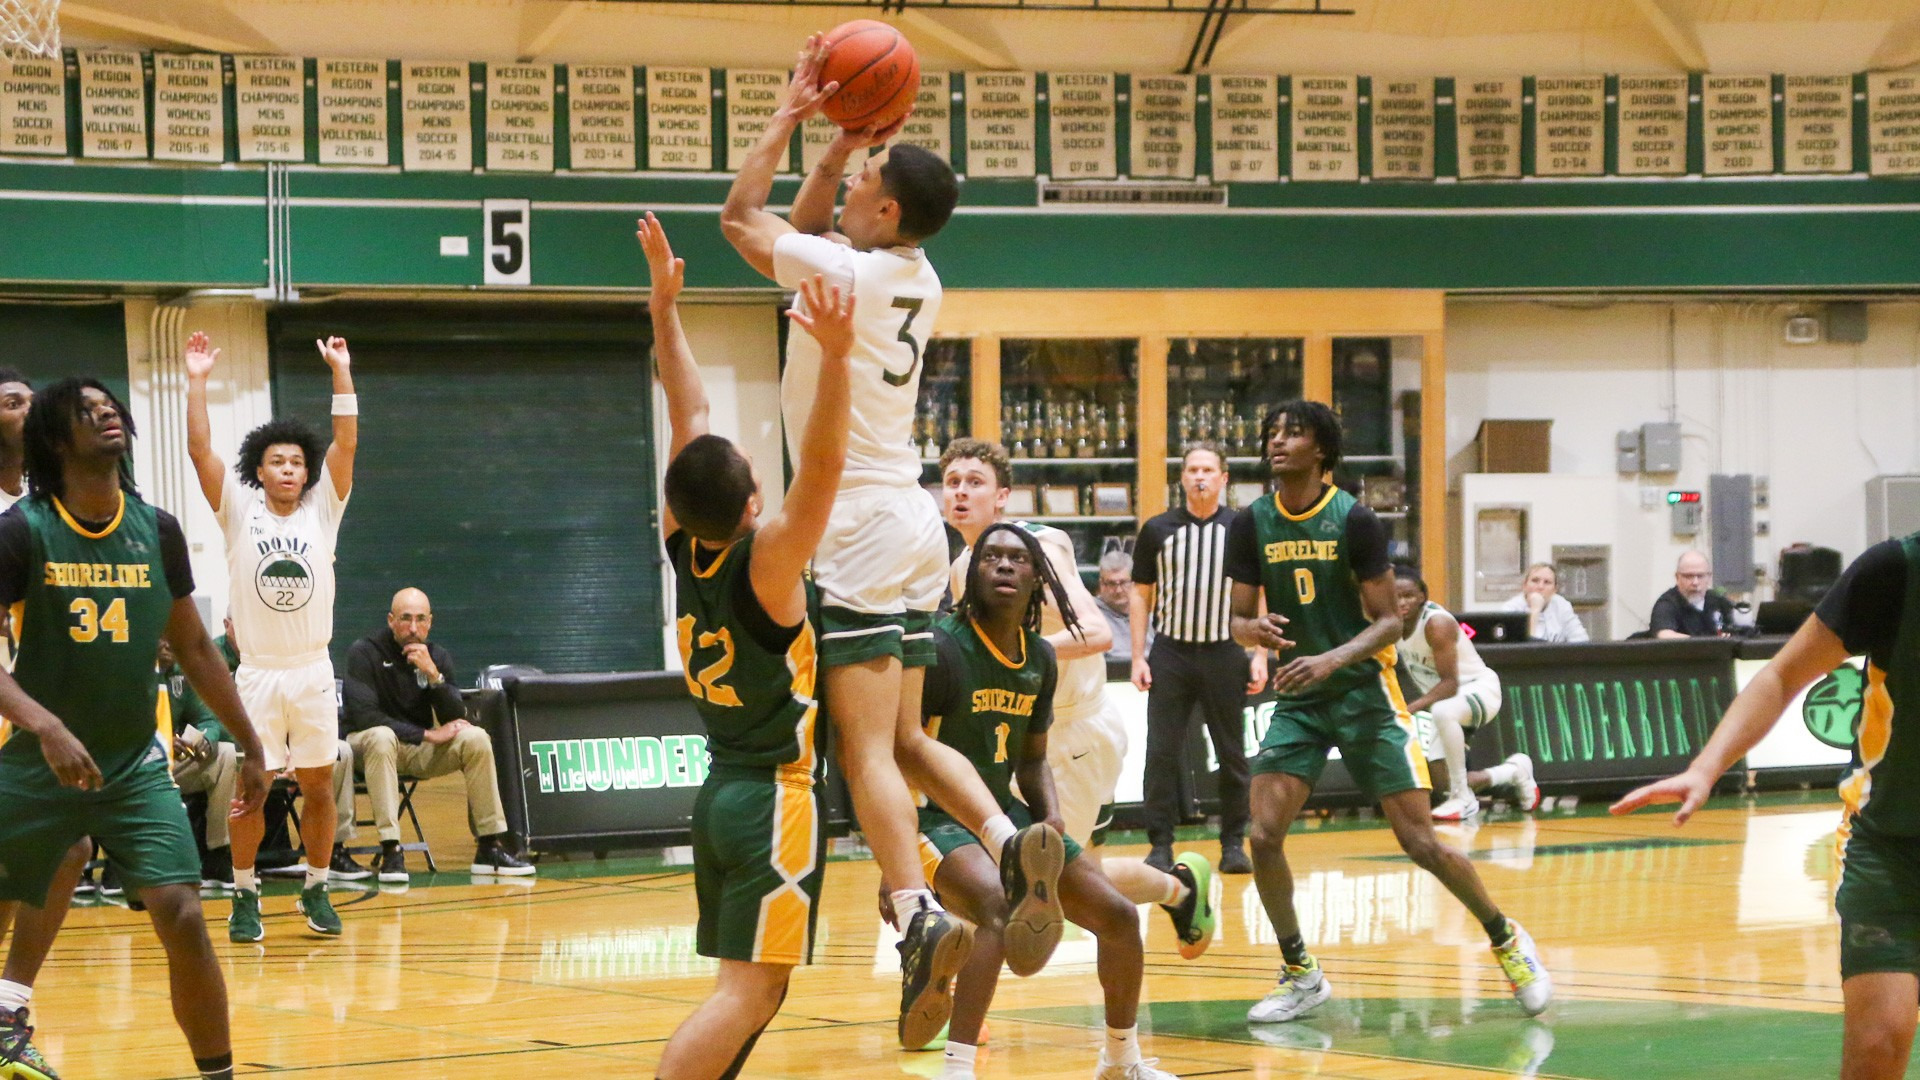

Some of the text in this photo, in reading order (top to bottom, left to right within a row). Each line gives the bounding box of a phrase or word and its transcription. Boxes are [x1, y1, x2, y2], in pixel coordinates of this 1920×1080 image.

[85, 55, 134, 66] WESTERN
[161, 59, 213, 70] WESTERN
[243, 60, 296, 71] WESTERN
[13, 65, 51, 77] REGION
[326, 62, 378, 73] WESTERN
[411, 66, 460, 77] WESTERN
[93, 72, 131, 82] REGION
[496, 68, 546, 79] WESTERN
[576, 68, 626, 78] WESTERN
[655, 72, 702, 82] WESTERN
[168, 75, 208, 87] REGION
[251, 76, 290, 87] REGION
[332, 78, 372, 90] REGION
[736, 74, 781, 84] WESTERN
[977, 76, 1025, 86] WESTERN
[1056, 75, 1108, 86] WESTERN
[1222, 78, 1267, 88] WESTERN
[1888, 79, 1915, 89] WEST
[4, 83, 60, 95] CHAMPIONS
[418, 83, 455, 94] REGION
[500, 84, 540, 95] REGION
[583, 84, 620, 94] REGION
[1302, 80, 1347, 90] WESTERN
[1538, 80, 1601, 90] SOUTHWEST
[1622, 80, 1686, 90] SOUTHWEST
[85, 87, 140, 99] CHAMPIONS
[160, 92, 218, 104] CHAMPIONS
[662, 88, 696, 98] REGION
[741, 90, 775, 100] REGION
[982, 93, 1020, 102] REGION
[1063, 91, 1100, 100] REGION
[1227, 93, 1263, 103] REGION
[242, 93, 299, 104] CHAMPIONS
[323, 97, 383, 108] CHAMPIONS
[1307, 96, 1342, 105] REGION
[1548, 96, 1593, 105] DIVISION
[1632, 95, 1676, 105] DIVISION
[17, 101, 47, 112] MENS
[93, 105, 134, 116] WOMENS
[407, 100, 465, 111] CHAMPIONS
[492, 101, 549, 112] CHAMPIONS
[572, 101, 630, 111] CHAMPIONS
[651, 105, 707, 114] CHAMPIONS
[167, 109, 210, 120] WOMENS
[258, 109, 284, 120] MENS
[972, 109, 1029, 119] CHAMPIONS
[1053, 107, 1110, 117] CHAMPIONS
[1217, 109, 1272, 119] CHAMPIONS
[1297, 111, 1352, 121] CHAMPIONS
[1541, 112, 1601, 122] CHAMPIONS
[1623, 111, 1684, 121] CHAMPIONS
[13, 117, 52, 129] SOCCER
[331, 113, 375, 124] WOMENS
[423, 117, 451, 127] MENS
[506, 117, 534, 128] MENS
[581, 117, 624, 127] WOMENS
[85, 123, 142, 134] VOLLEYBALL
[658, 120, 700, 129] WOMENS
[904, 124, 932, 134] MENS
[987, 125, 1015, 134] MENS
[1061, 123, 1105, 132] WOMENS
[1232, 125, 1258, 134] MENS
[168, 124, 209, 136] SOCCER
[252, 125, 291, 136] SOCCER
[321, 129, 383, 140] VOLLEYBALL
[1304, 127, 1346, 137] WOMENS
[1548, 127, 1592, 136] WOMENS
[1638, 126, 1668, 135] MENS
[15, 135, 52, 146] 2016-17
[417, 133, 457, 143] SOCCER
[487, 134, 551, 144] BASKETBALL
[572, 133, 633, 143] VOLLEYBALL
[650, 136, 709, 146] VOLLEYBALL
[98, 139, 132, 151] 2016-17
[169, 142, 209, 153] 2015-16
[970, 141, 1031, 150] BASKETBALL
[1063, 139, 1104, 149] SOCCER
[1216, 141, 1272, 150] BASKETBALL
[1297, 142, 1351, 152] BASKETBALL
[1550, 142, 1591, 152] SOCCER
[1632, 141, 1674, 150] SOCCER
[335, 145, 374, 157] 2015-16
[419, 150, 456, 160] 2014-15
[502, 150, 539, 160] 2014-15
[491, 210, 523, 274] 5
[883, 296, 923, 386] 3
[45, 562, 151, 587] SHORELINE
[1294, 568, 1315, 605] 0
[276, 590, 294, 606] 22
[70, 598, 129, 643] 34
[677, 613, 744, 706] 12
[994, 722, 1010, 763] 1
